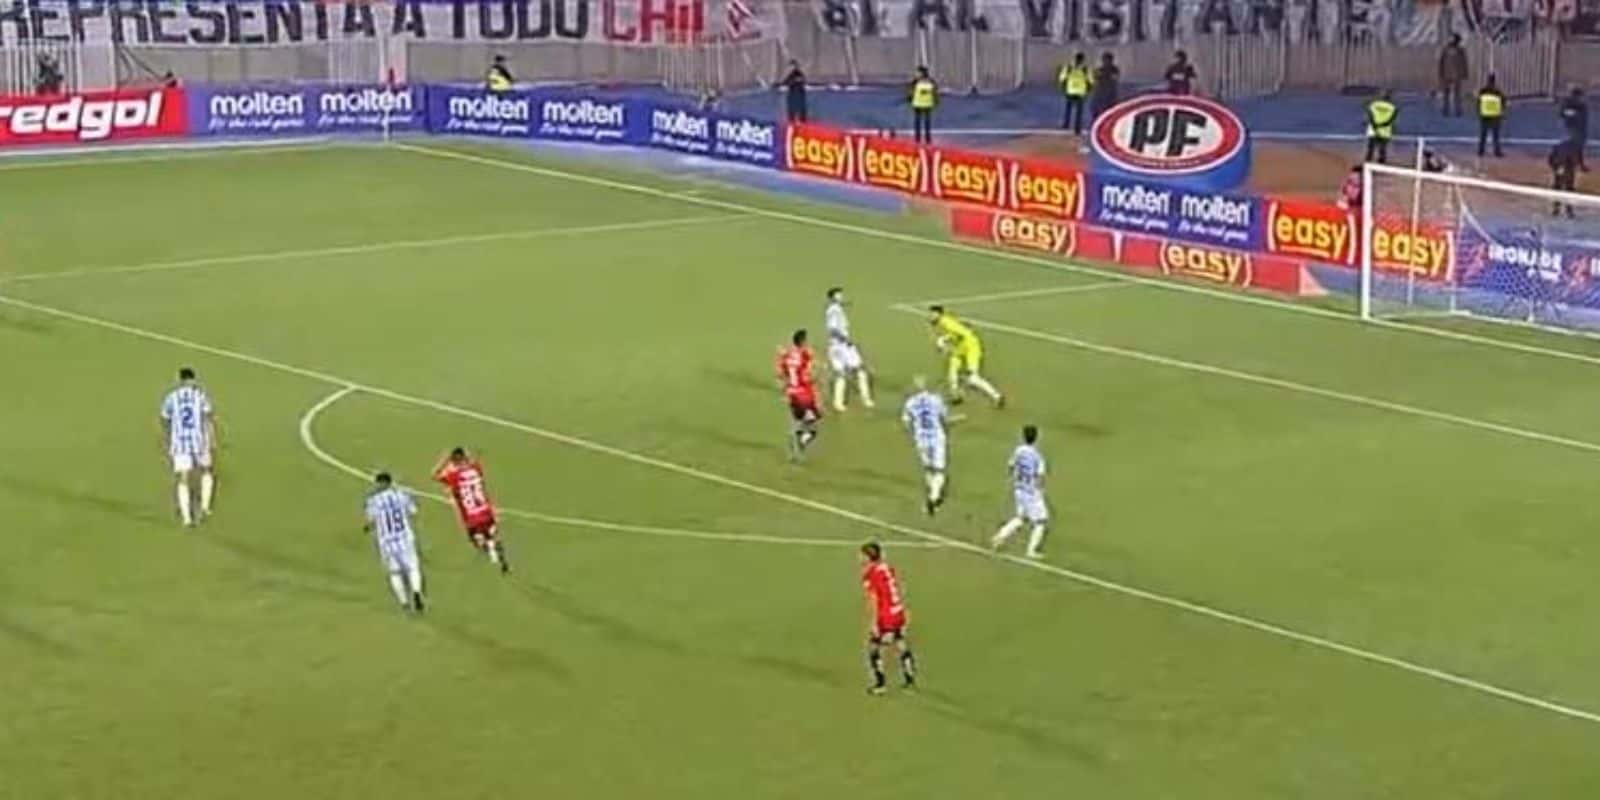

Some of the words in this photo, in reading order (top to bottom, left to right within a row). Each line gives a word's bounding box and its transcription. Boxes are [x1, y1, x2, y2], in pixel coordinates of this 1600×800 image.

[210, 91, 304, 115] molten
[320, 87, 413, 112] molten
[449, 94, 529, 119] molten
[543, 100, 624, 126] molten
[1129, 107, 1208, 158] PF
[180, 407, 194, 428] 2
